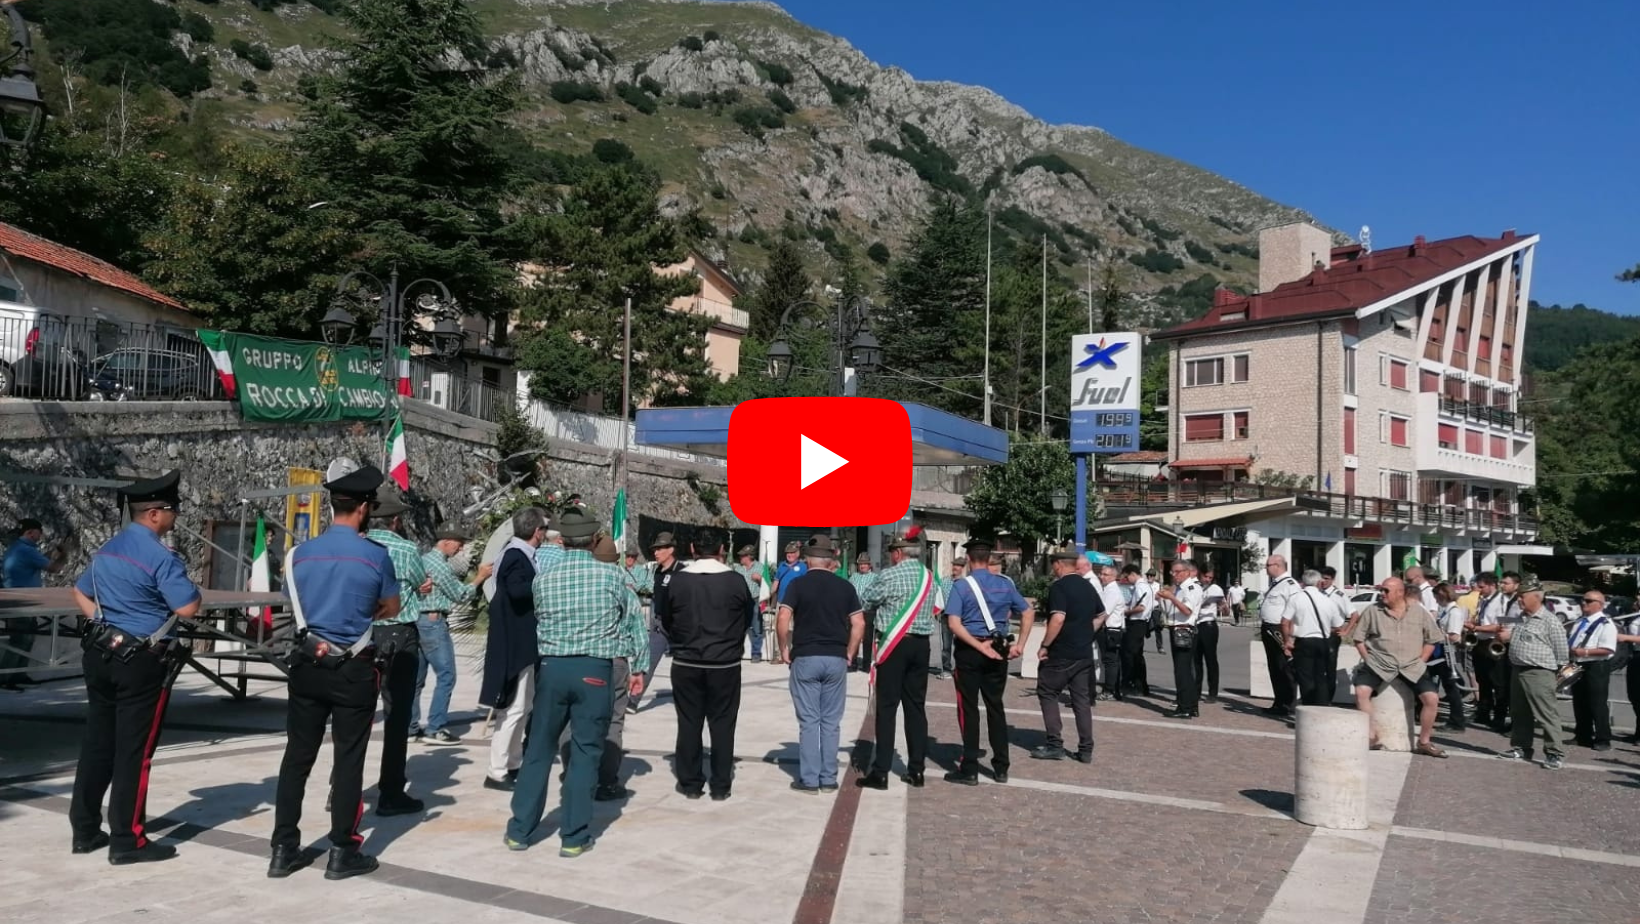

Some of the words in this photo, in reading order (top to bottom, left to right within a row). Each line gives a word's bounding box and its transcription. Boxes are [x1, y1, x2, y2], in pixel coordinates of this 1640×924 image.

[243, 347, 302, 370] GRUPPO
[348, 357, 383, 376] ALPIN
[246, 382, 310, 408] ROCCA
[311, 387, 327, 408] DI
[338, 386, 386, 409] CAMBIO
